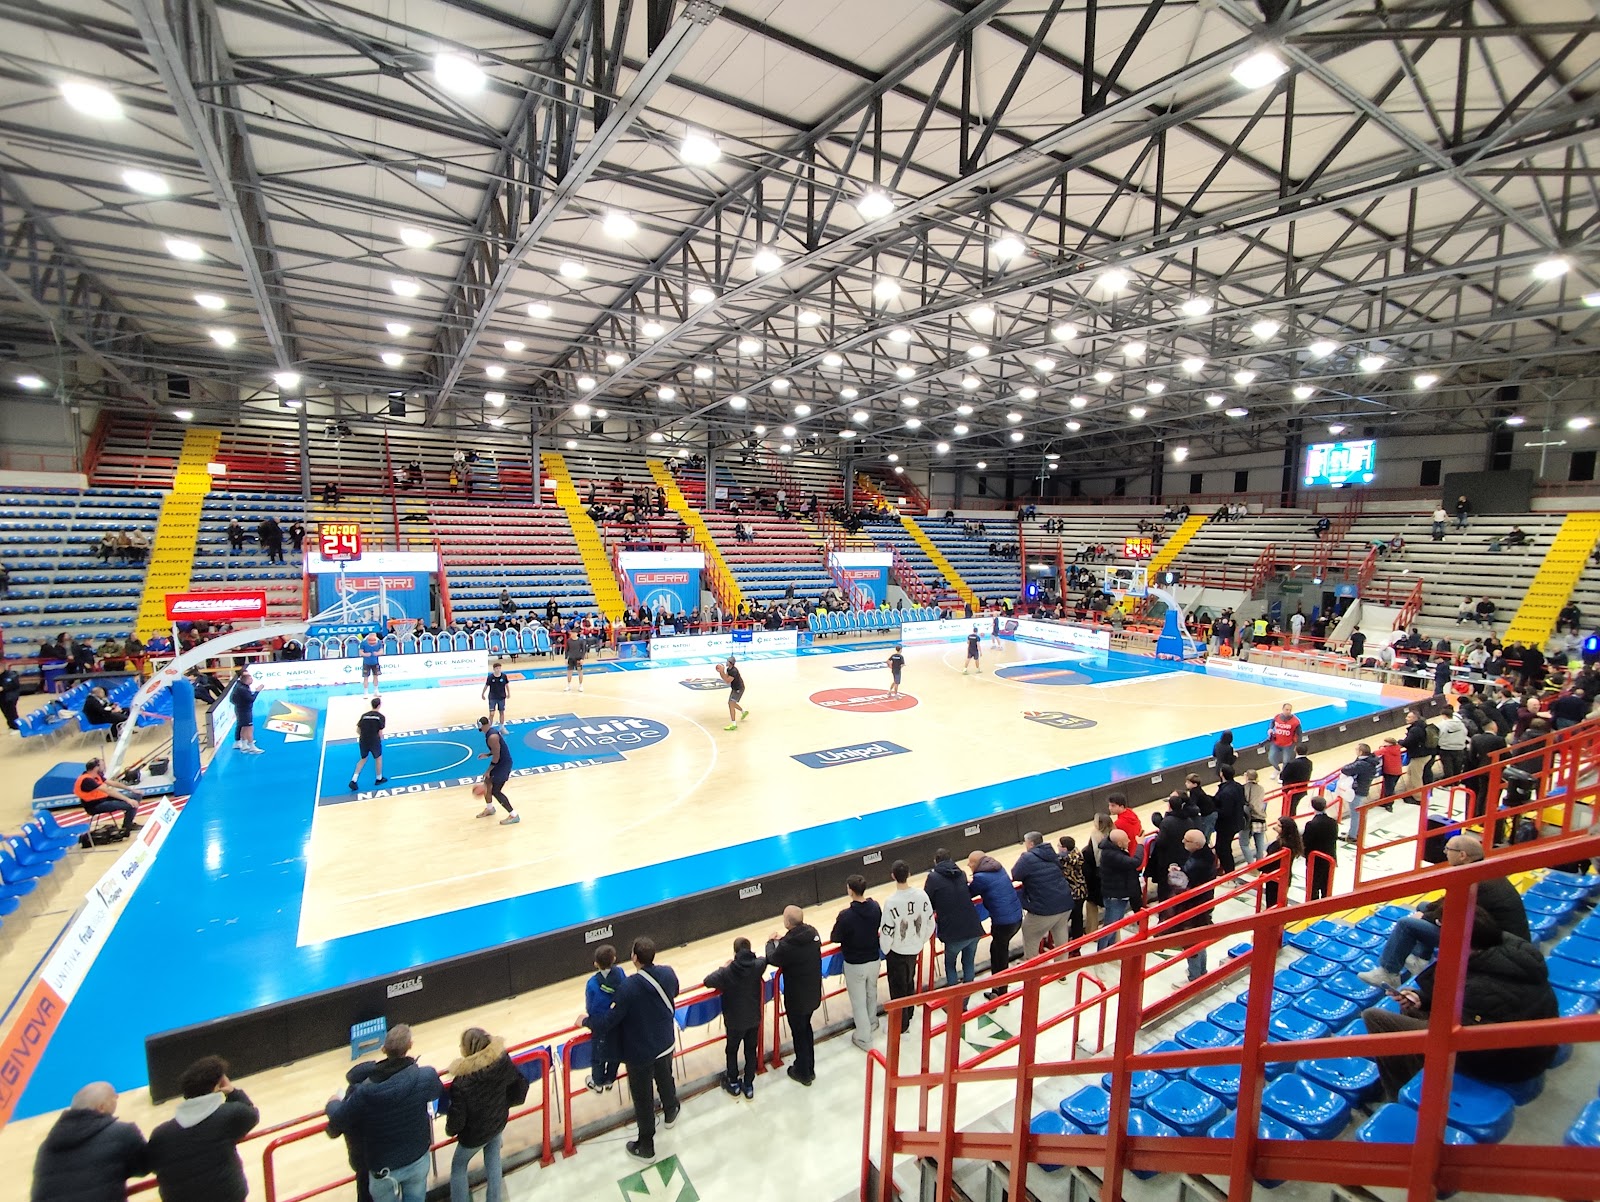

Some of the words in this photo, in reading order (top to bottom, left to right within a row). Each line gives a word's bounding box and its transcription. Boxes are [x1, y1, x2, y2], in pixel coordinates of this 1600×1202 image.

[322, 525, 357, 535] 20:00
[324, 536, 357, 554] 24
[1126, 543, 1140, 554] 24
[636, 574, 688, 583] GUERRI
[318, 626, 375, 634] ALCOTT
[536, 718, 650, 740] fruit
[547, 728, 663, 750] village
[816, 743, 889, 758] Unipol
[357, 781, 446, 800] NAPOLI
[458, 758, 603, 786] BAKETBALL
[54, 948, 81, 989] UNITIVA
[0, 996, 56, 1086] GIVOVA
